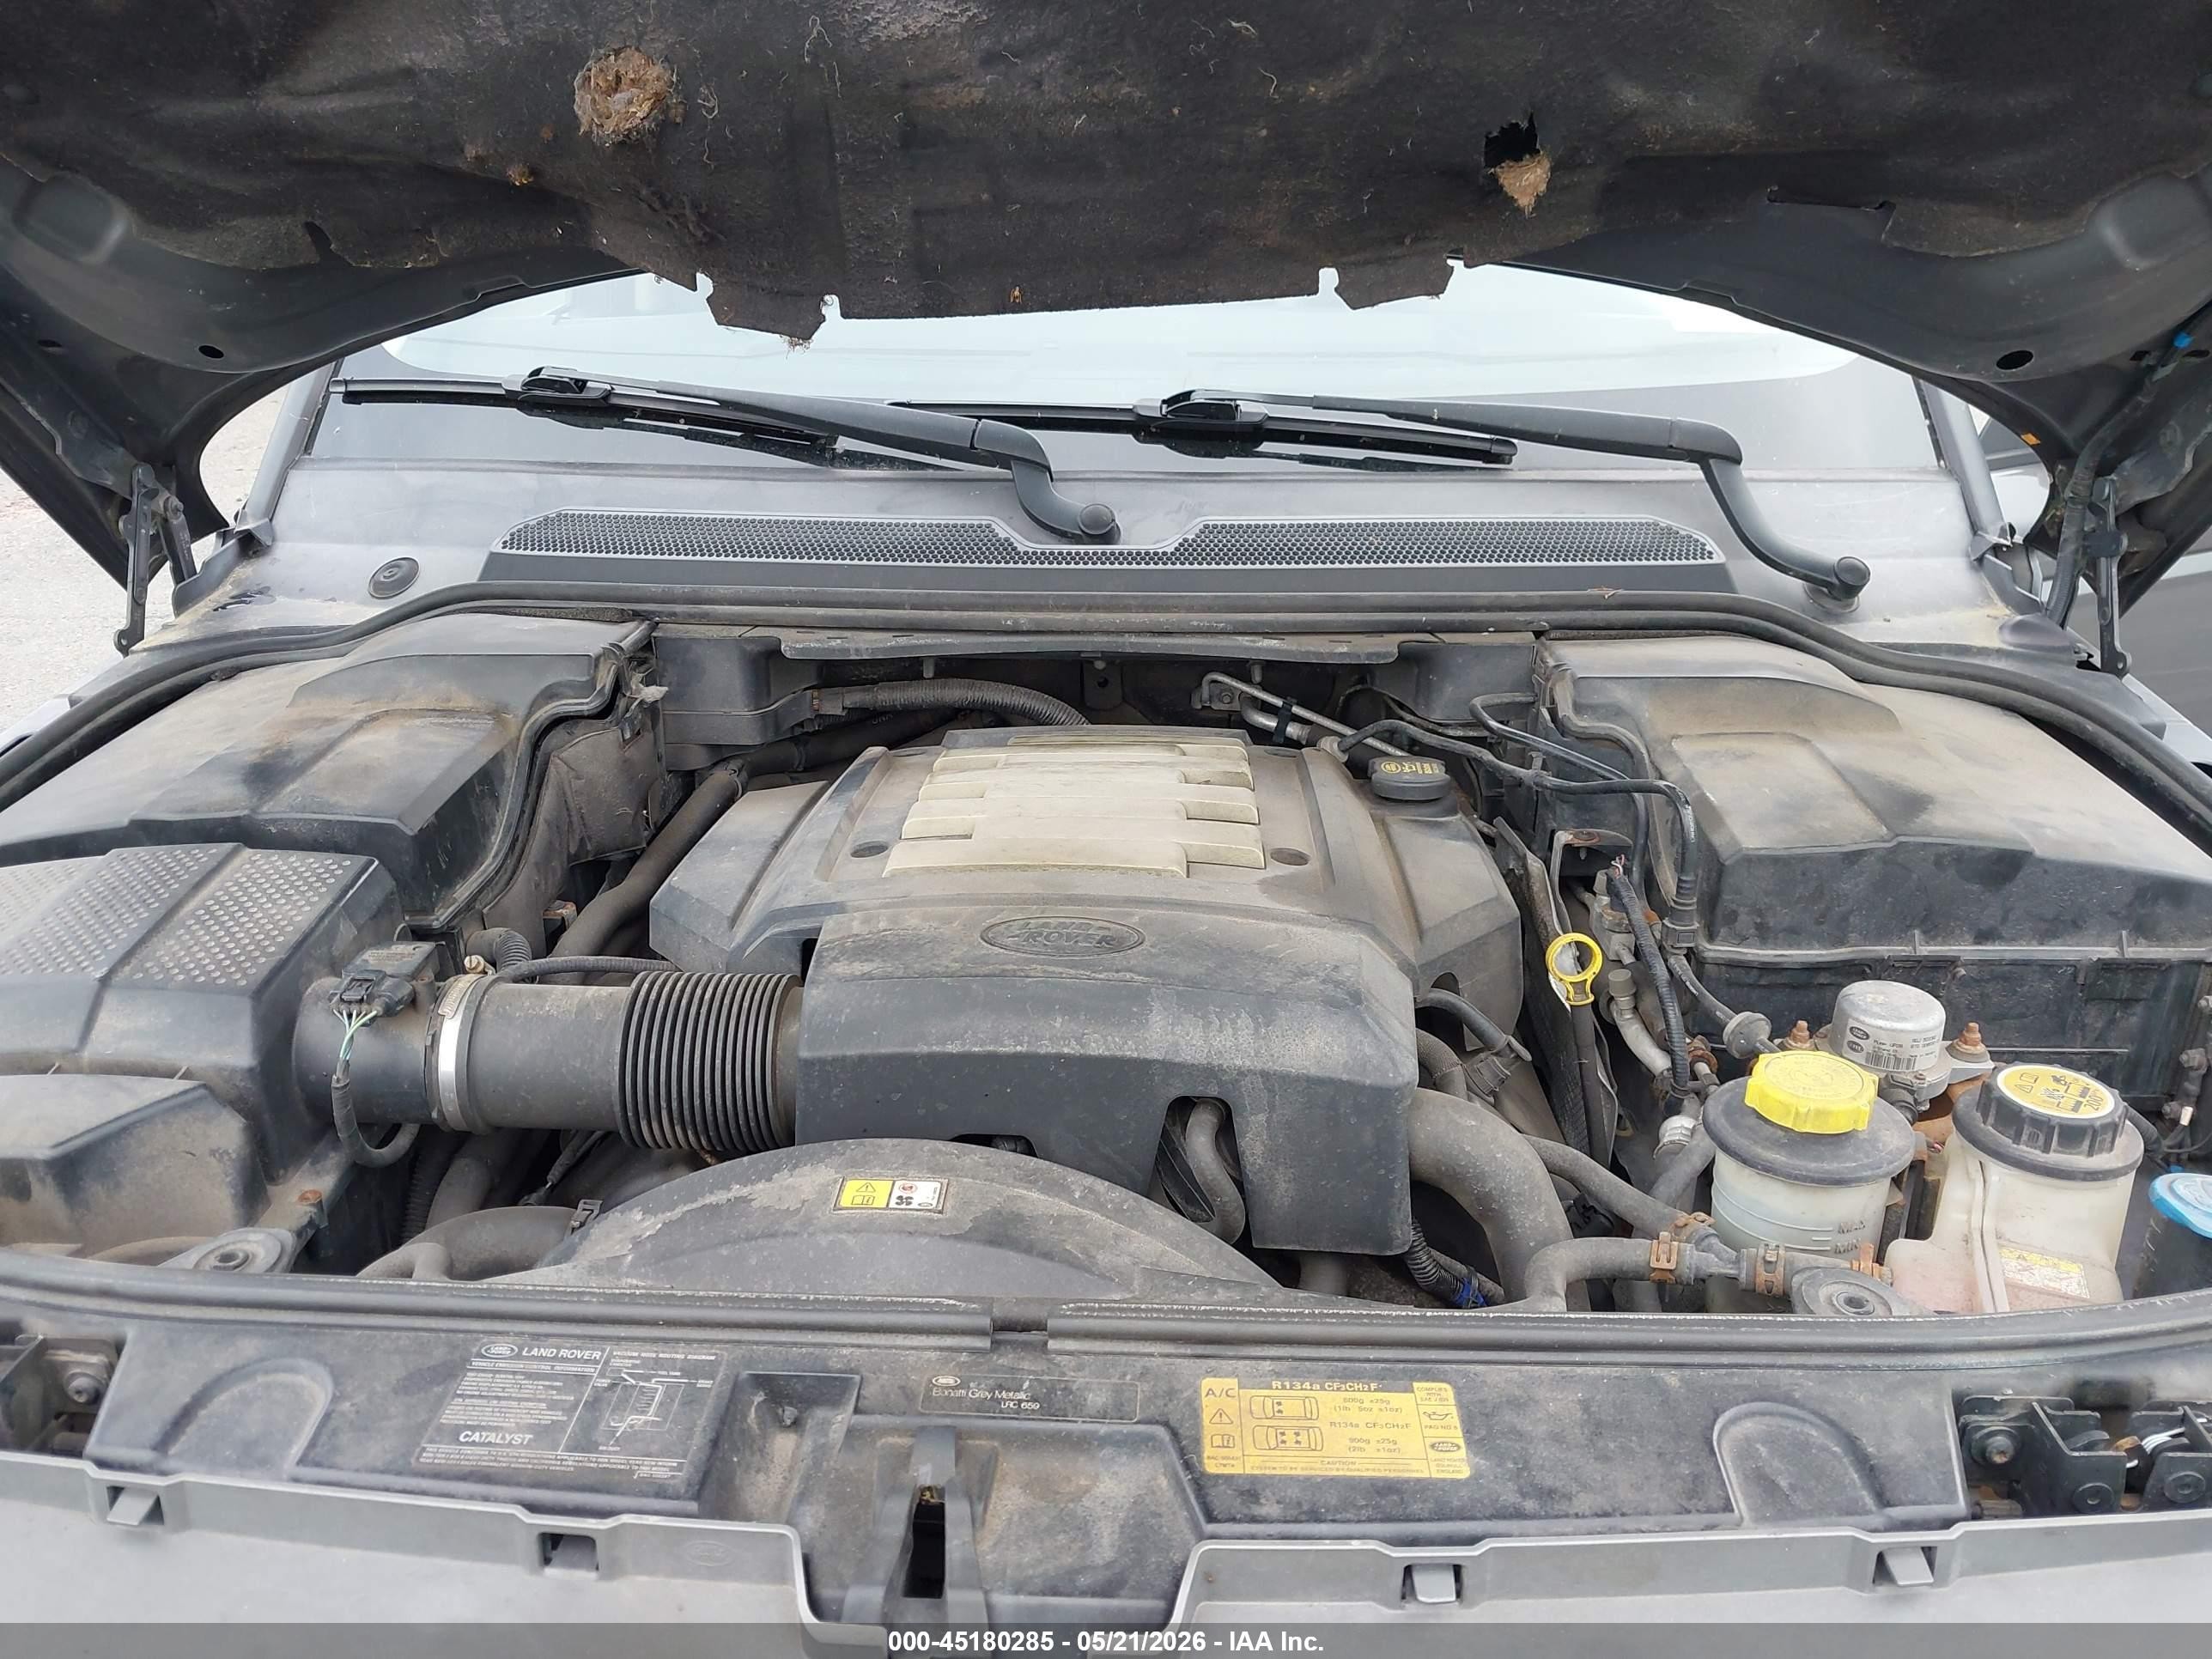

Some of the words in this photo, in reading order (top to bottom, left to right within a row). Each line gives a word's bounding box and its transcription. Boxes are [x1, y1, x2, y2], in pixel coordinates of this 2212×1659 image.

[1022, 931, 1117, 945] ROVER
[522, 1347, 556, 1357] LAND
[558, 1349, 602, 1360] ROVER
[1272, 1381, 1320, 1390] R134a
[933, 1388, 967, 1398] Bonatti
[969, 1389, 993, 1401] Grey
[994, 1390, 1031, 1400] Metallic
[1205, 1388, 1237, 1398] A/C
[459, 1431, 533, 1445] CATALYST
